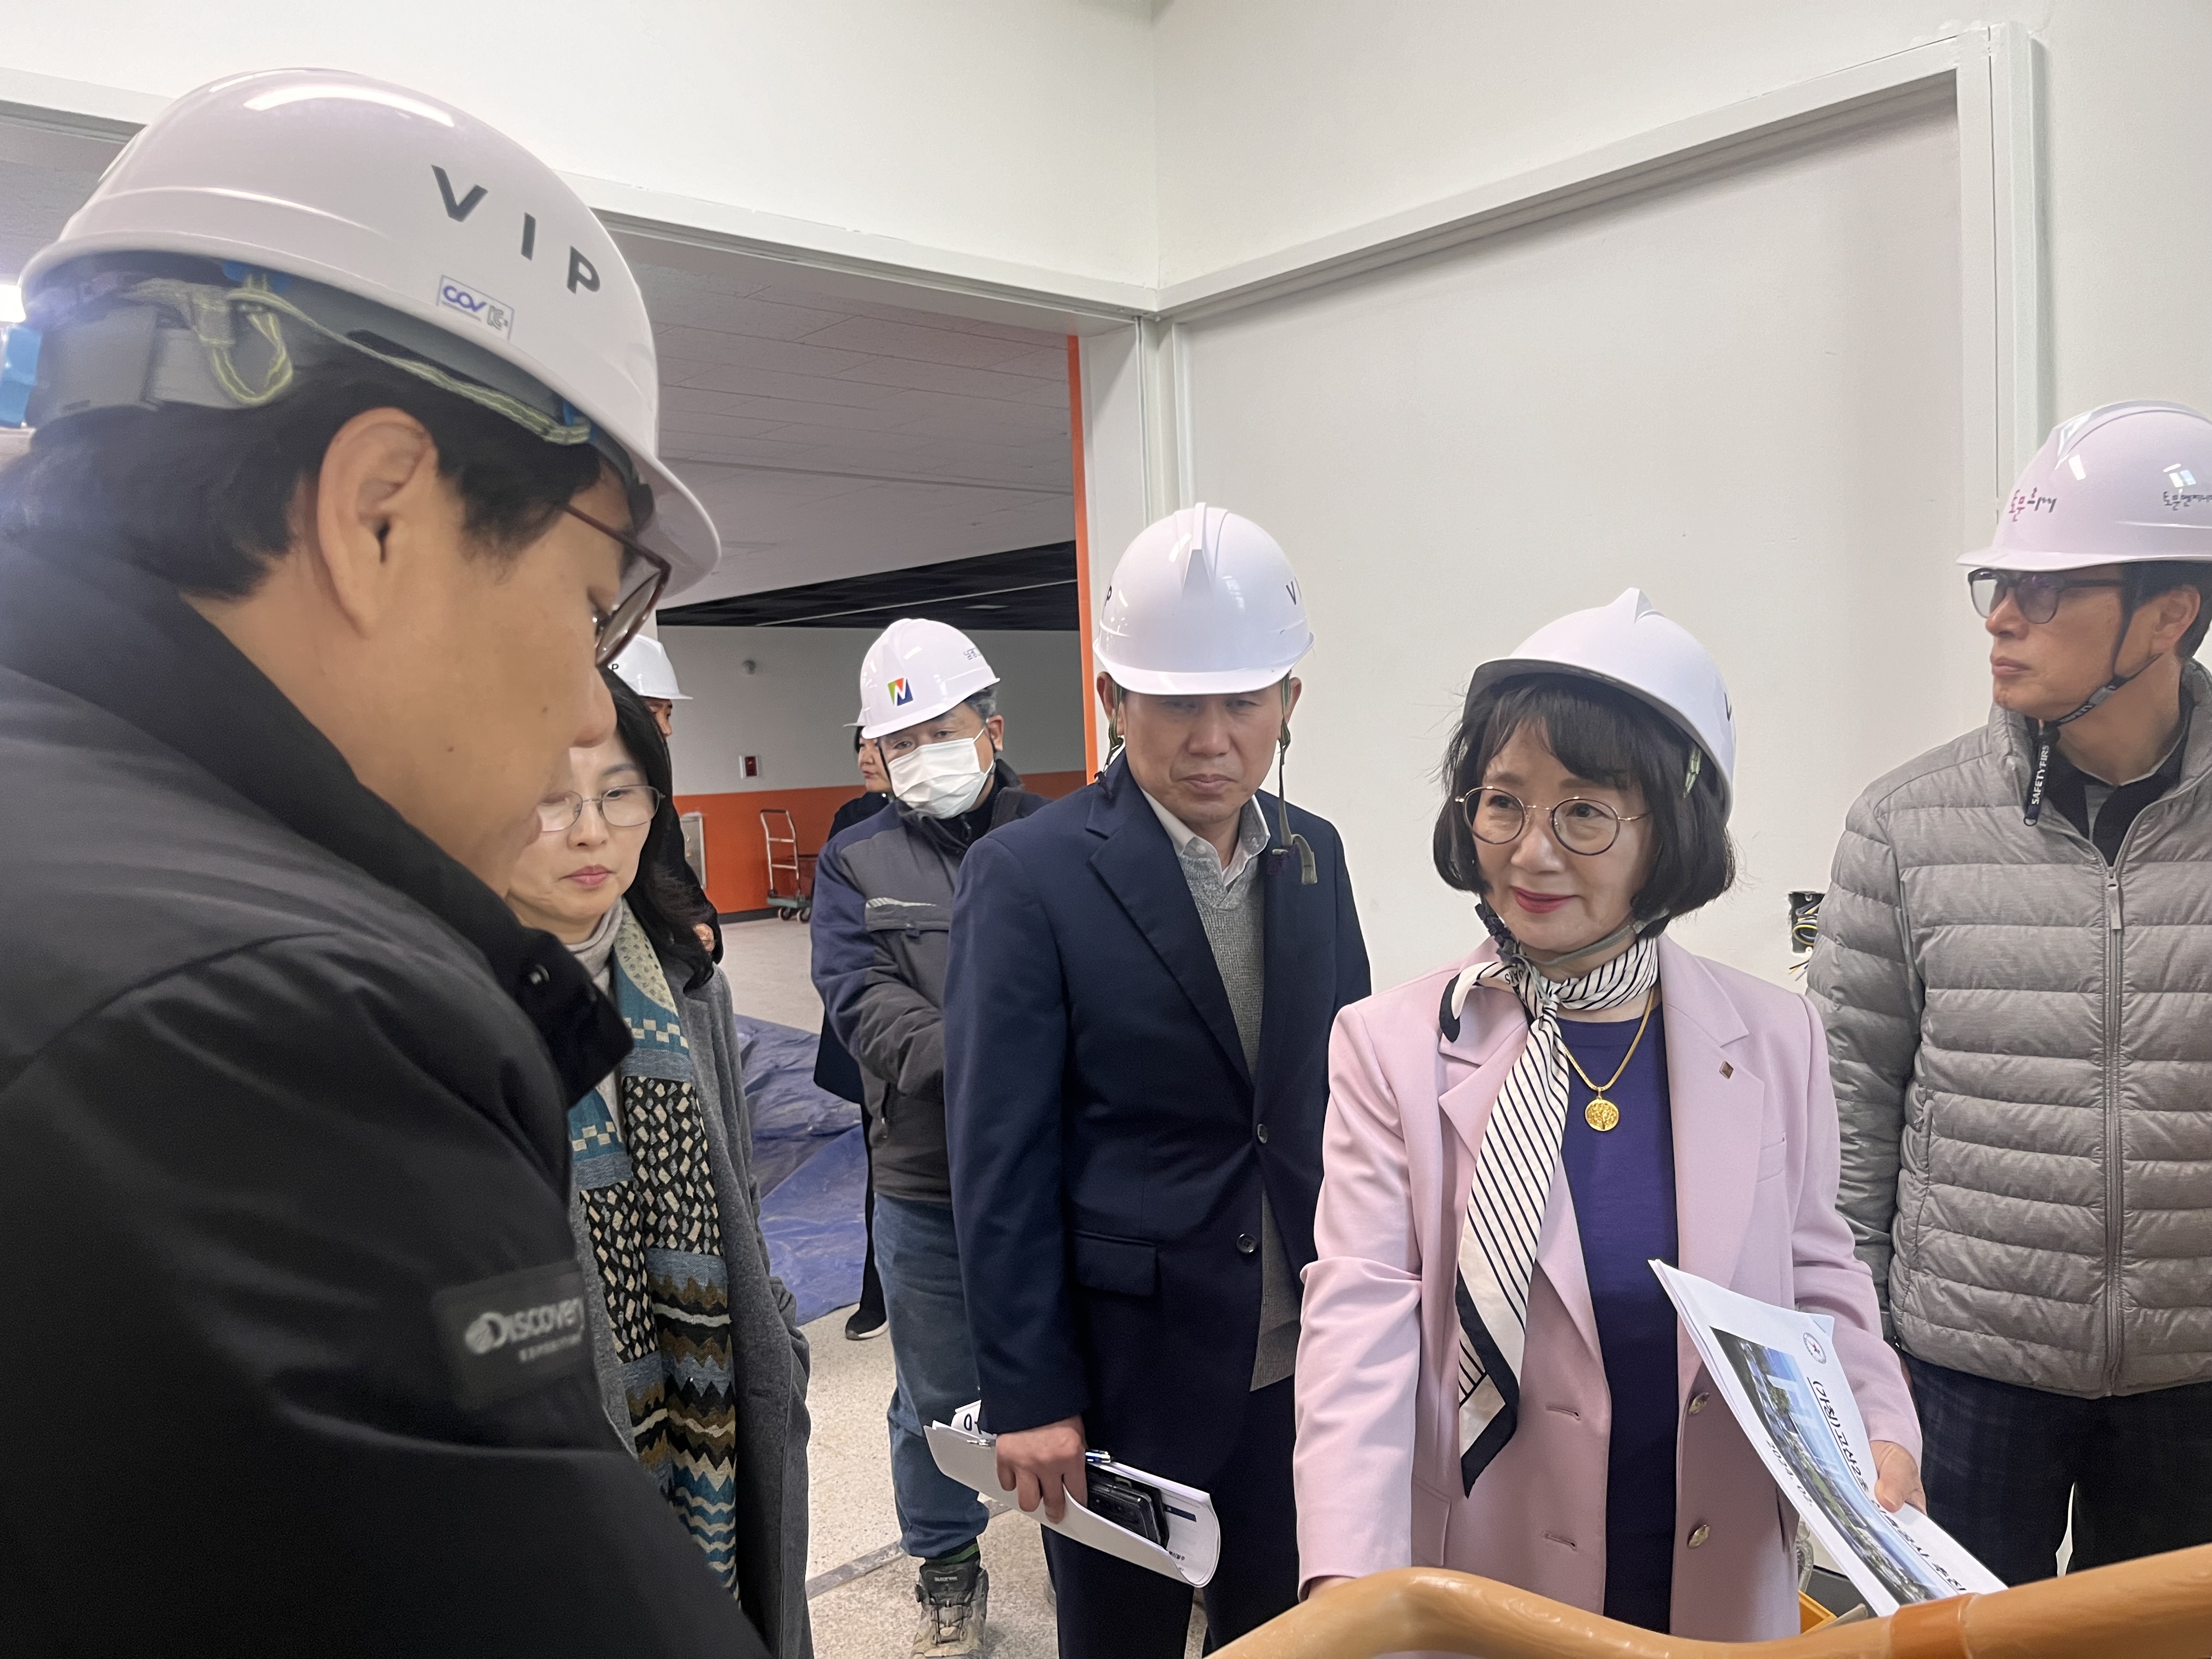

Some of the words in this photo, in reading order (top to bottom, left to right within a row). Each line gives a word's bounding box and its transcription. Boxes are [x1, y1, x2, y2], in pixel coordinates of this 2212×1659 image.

[431, 164, 600, 294] VIP
[2032, 769, 2045, 805] SAFETY
[2039, 745, 2050, 769] FIRS
[1766, 1440, 1793, 1480] 2024.
